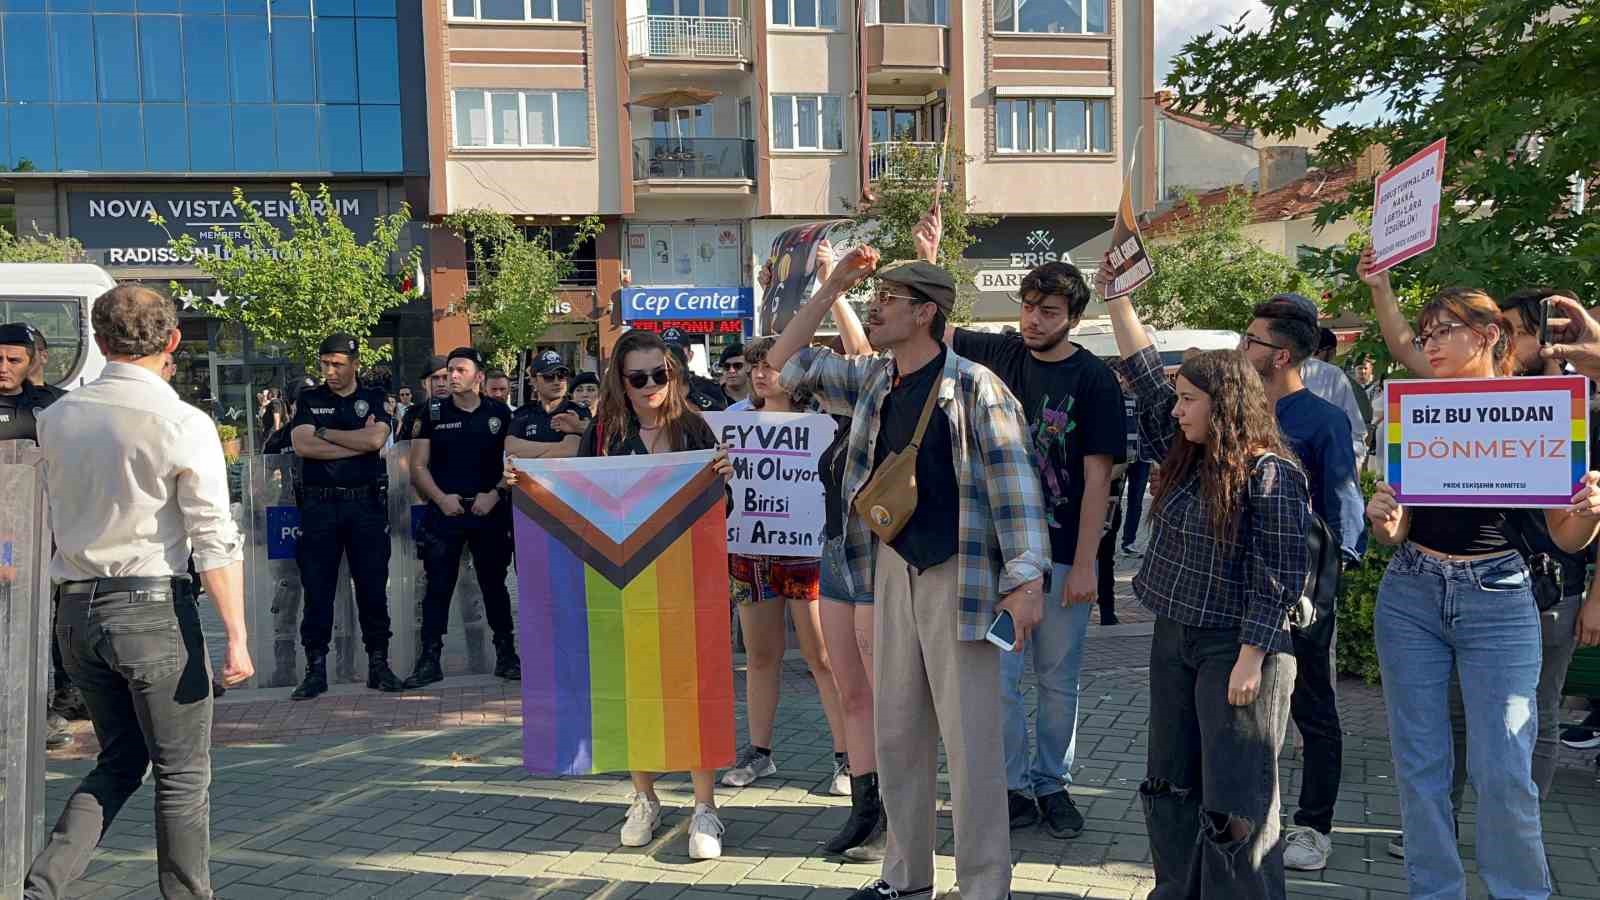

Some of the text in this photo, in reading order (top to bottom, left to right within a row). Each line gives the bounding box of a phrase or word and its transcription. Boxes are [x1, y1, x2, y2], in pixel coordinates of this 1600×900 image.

[89, 199, 359, 218] NOVA VISTA CENRM
[632, 292, 739, 315] Cep Center
[1412, 404, 1554, 424] BİZ BU YOLDAN
[721, 425, 810, 450] EYVAH
[1407, 434, 1568, 459] DÖNMEYİZ
[757, 457, 819, 483] Oluyor
[744, 487, 789, 513] Birisi
[727, 527, 740, 543] si
